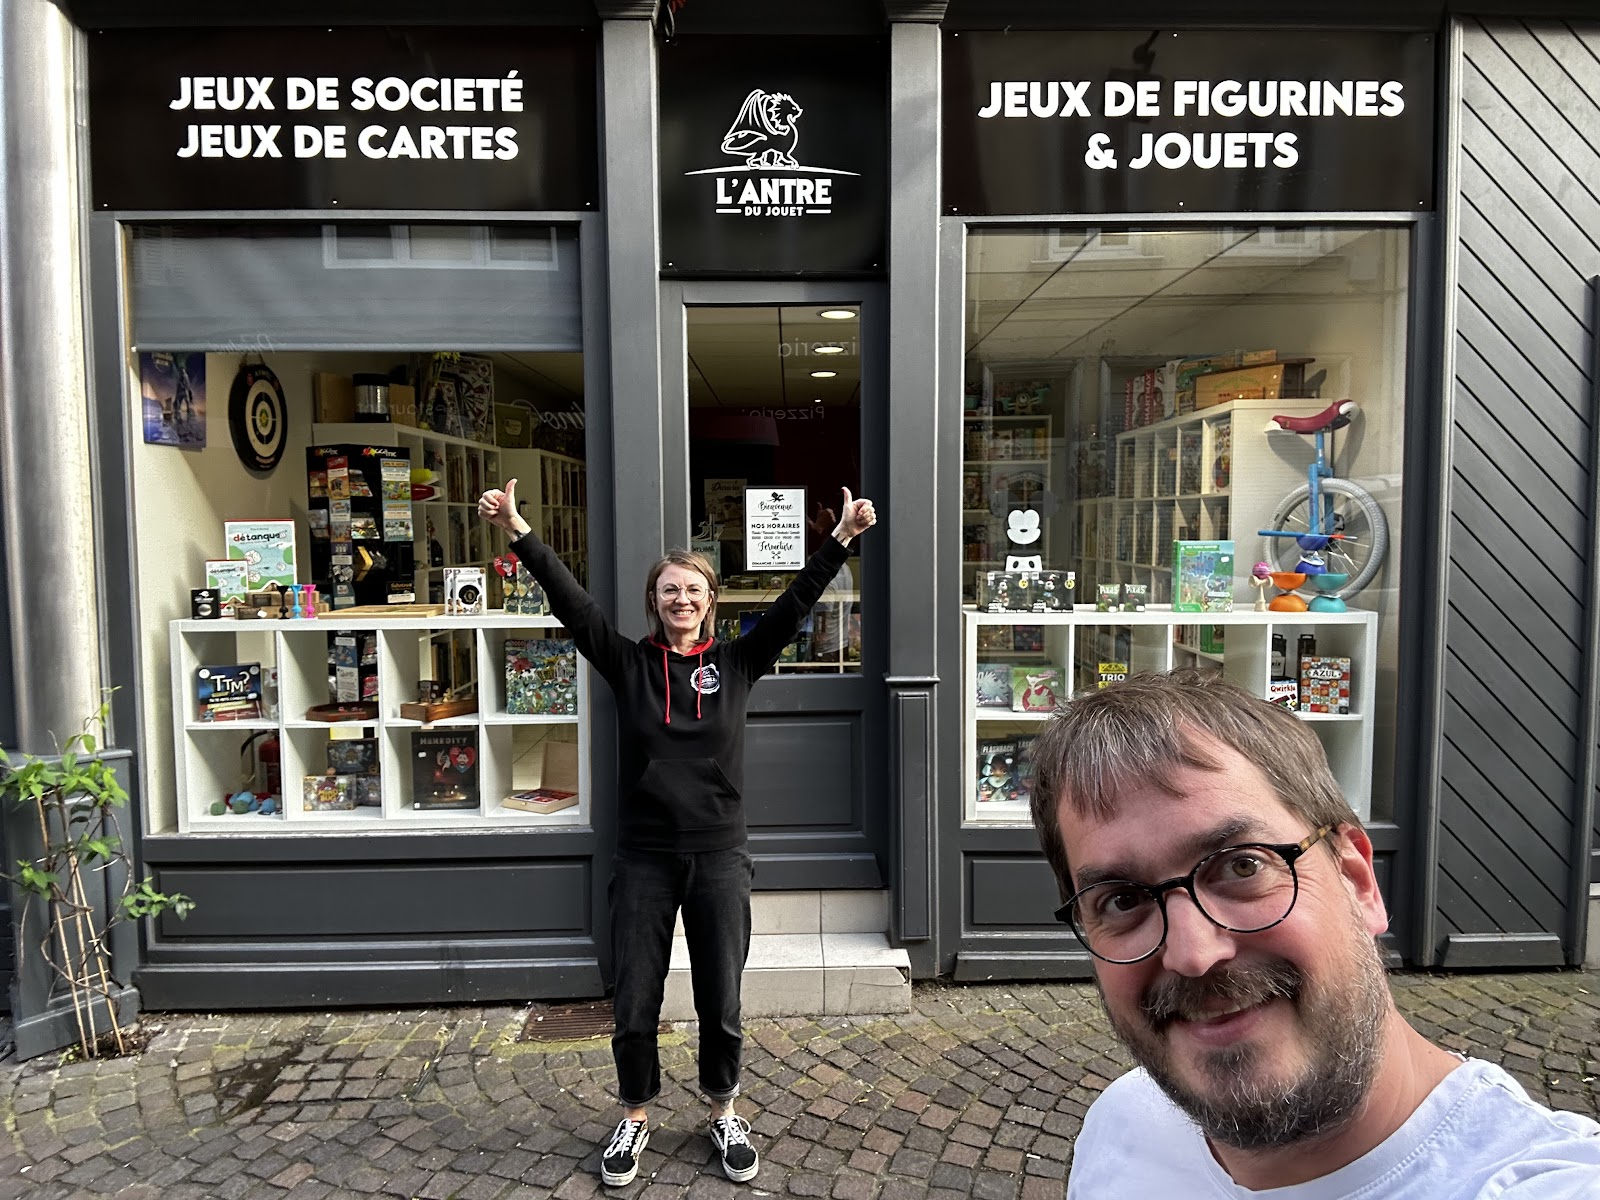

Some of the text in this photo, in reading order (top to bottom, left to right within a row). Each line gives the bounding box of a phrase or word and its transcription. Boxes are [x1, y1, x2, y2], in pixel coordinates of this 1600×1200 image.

[169, 69, 524, 112] JEUX DE SOCIETÉ
[977, 79, 1405, 118] JEUX DE FIGURINES
[177, 124, 519, 160] JEUX DE CARTES
[1084, 132, 1299, 170] & JOUETS
[715, 177, 832, 205] L'ANTRE
[744, 206, 804, 217] DU JOUET
[1100, 673, 1126, 682] TRIO
[1312, 669, 1338, 678] AZUL
